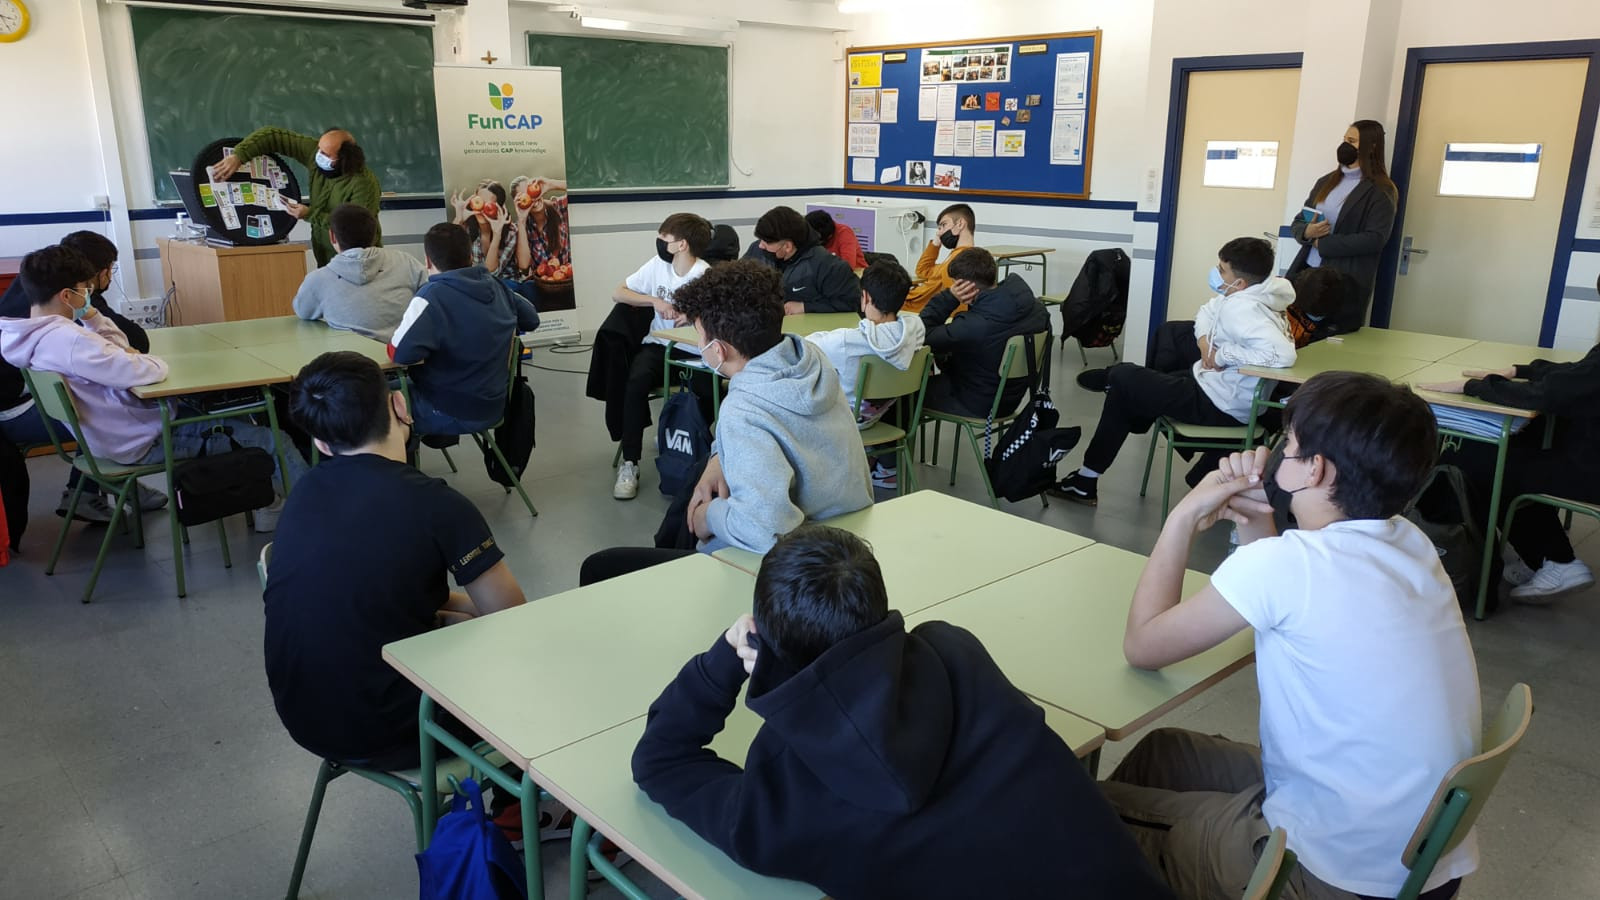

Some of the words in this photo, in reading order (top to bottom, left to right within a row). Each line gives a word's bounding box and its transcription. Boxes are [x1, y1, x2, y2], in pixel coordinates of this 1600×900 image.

[467, 113, 543, 130] FunCAP
[463, 147, 500, 155] generations
[514, 147, 546, 155] knowledge
